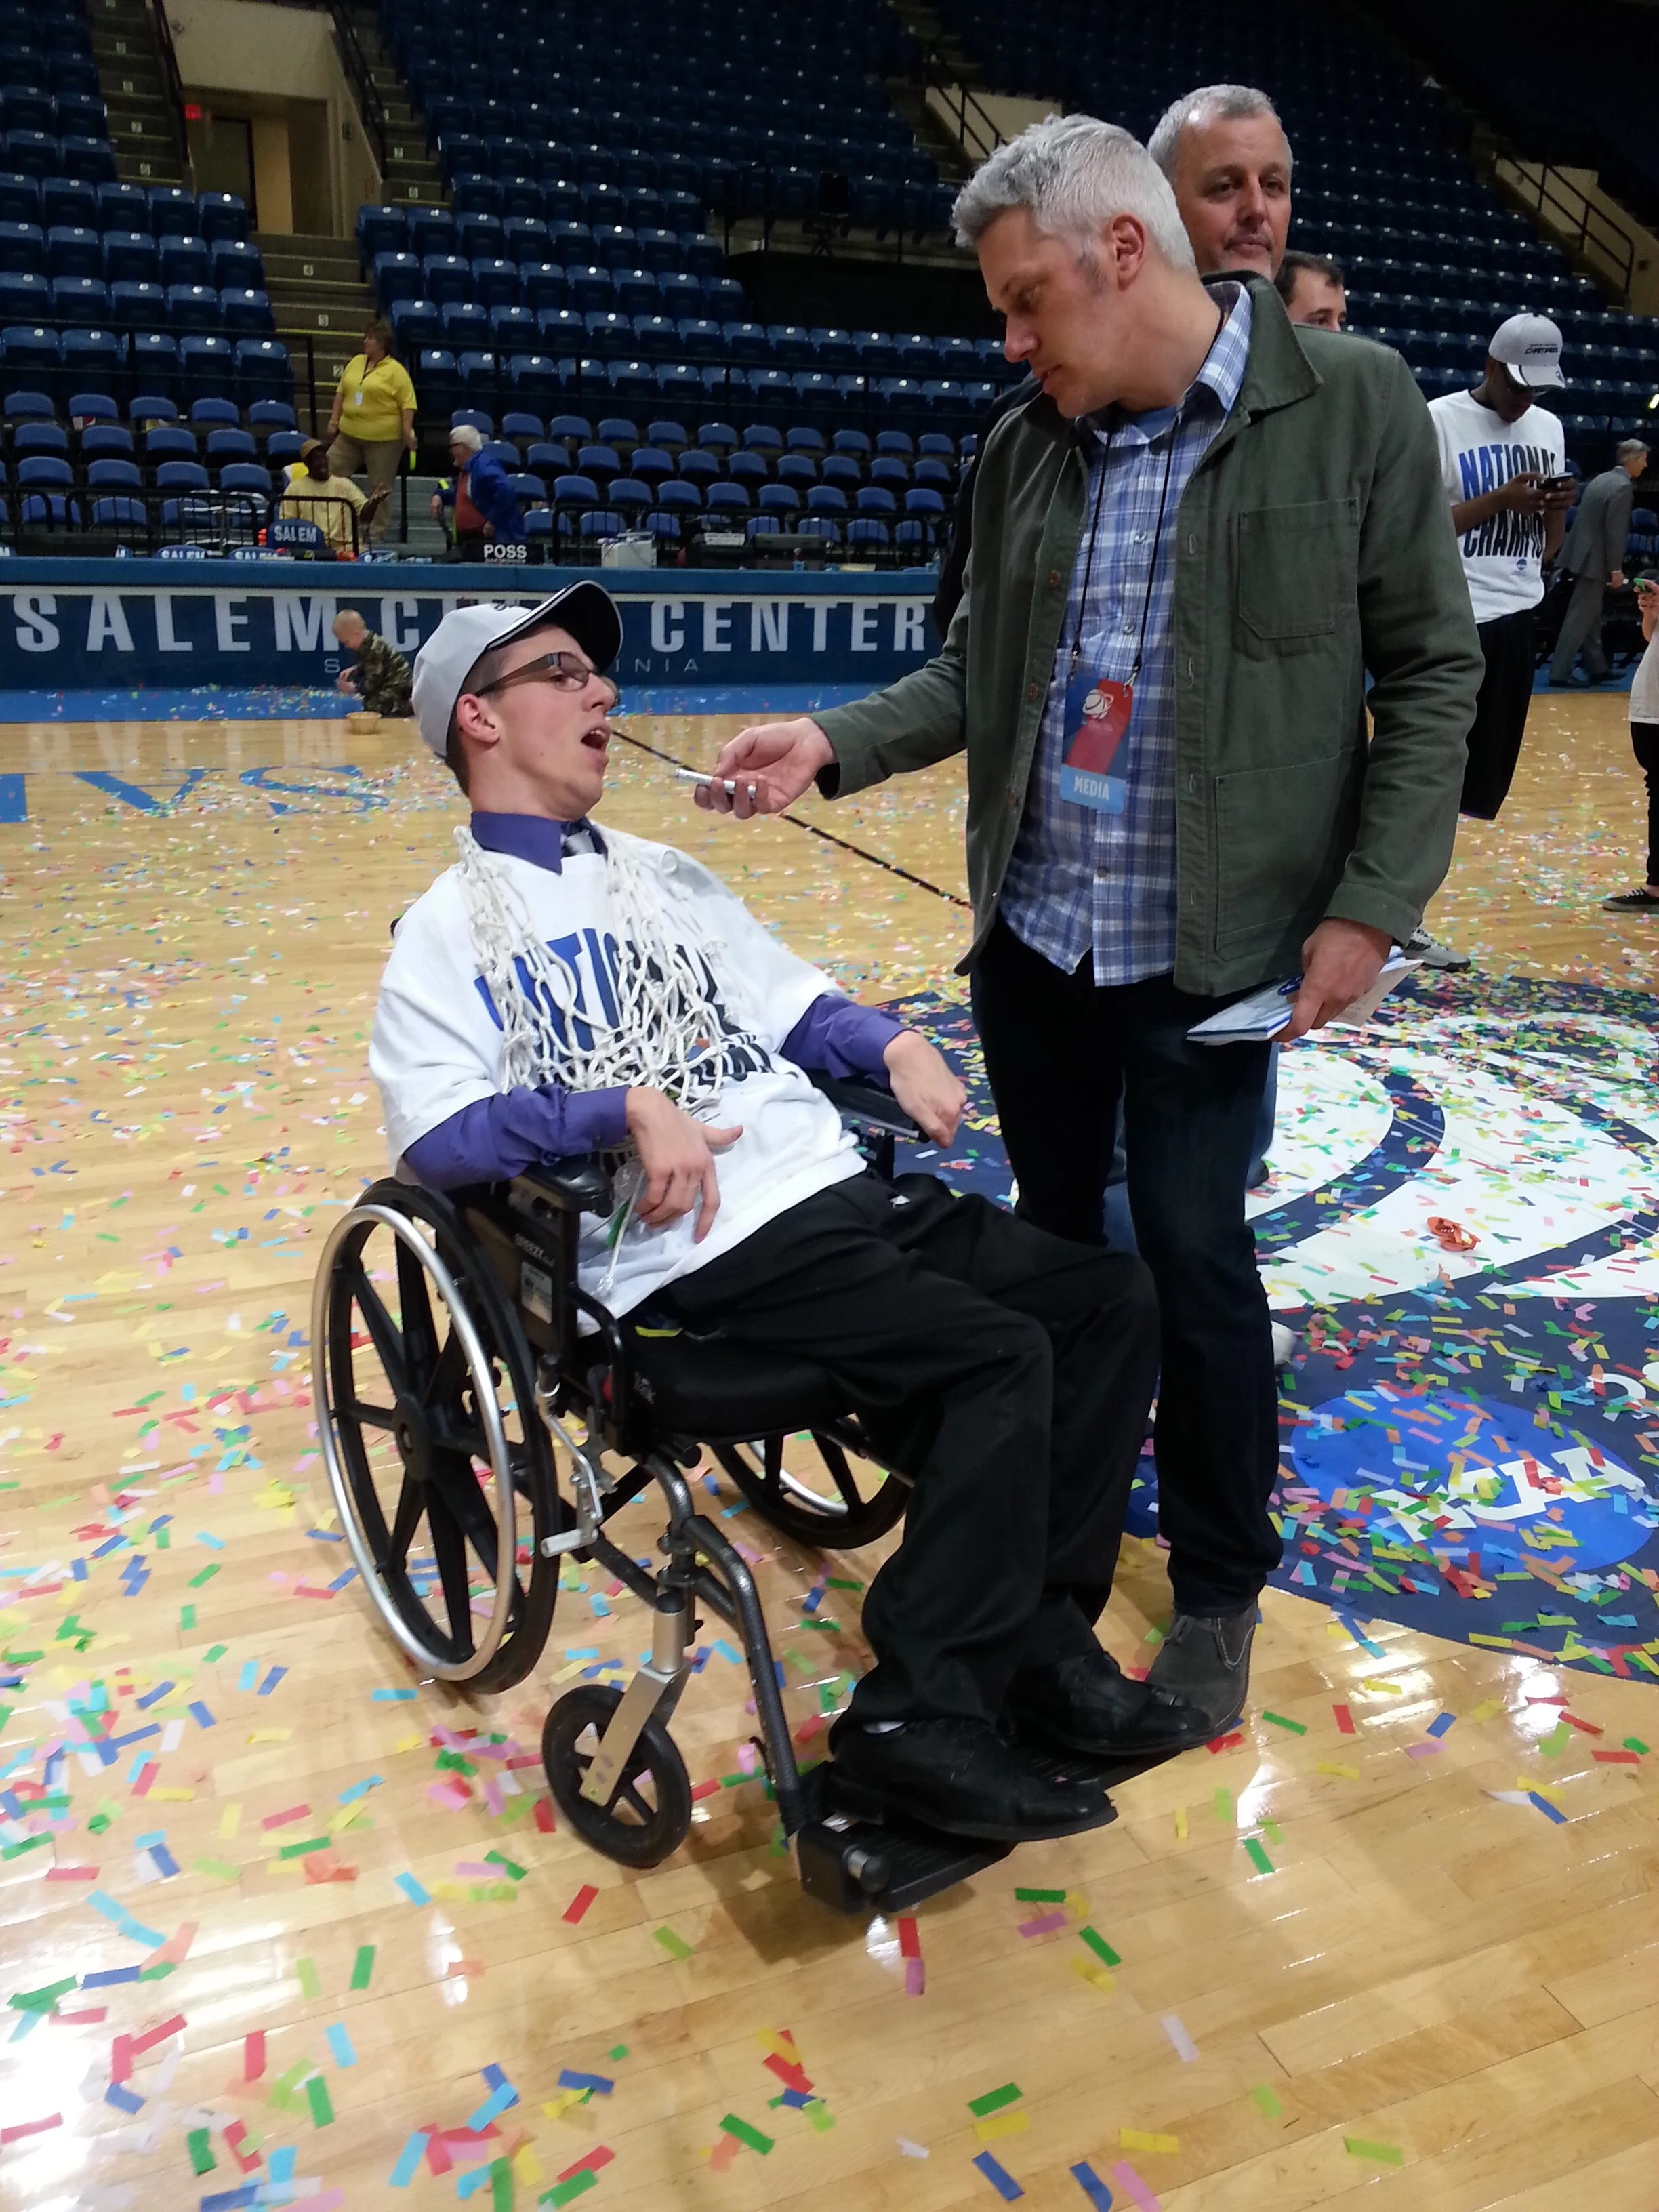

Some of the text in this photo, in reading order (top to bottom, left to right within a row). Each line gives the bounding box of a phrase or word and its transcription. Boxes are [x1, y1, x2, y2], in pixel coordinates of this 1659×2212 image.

[274, 525, 317, 543] SALEM
[483, 544, 527, 558] POSS
[13, 596, 340, 652] SALEM
[651, 601, 925, 653] CENTER
[1073, 776, 1110, 800] MEDIA
